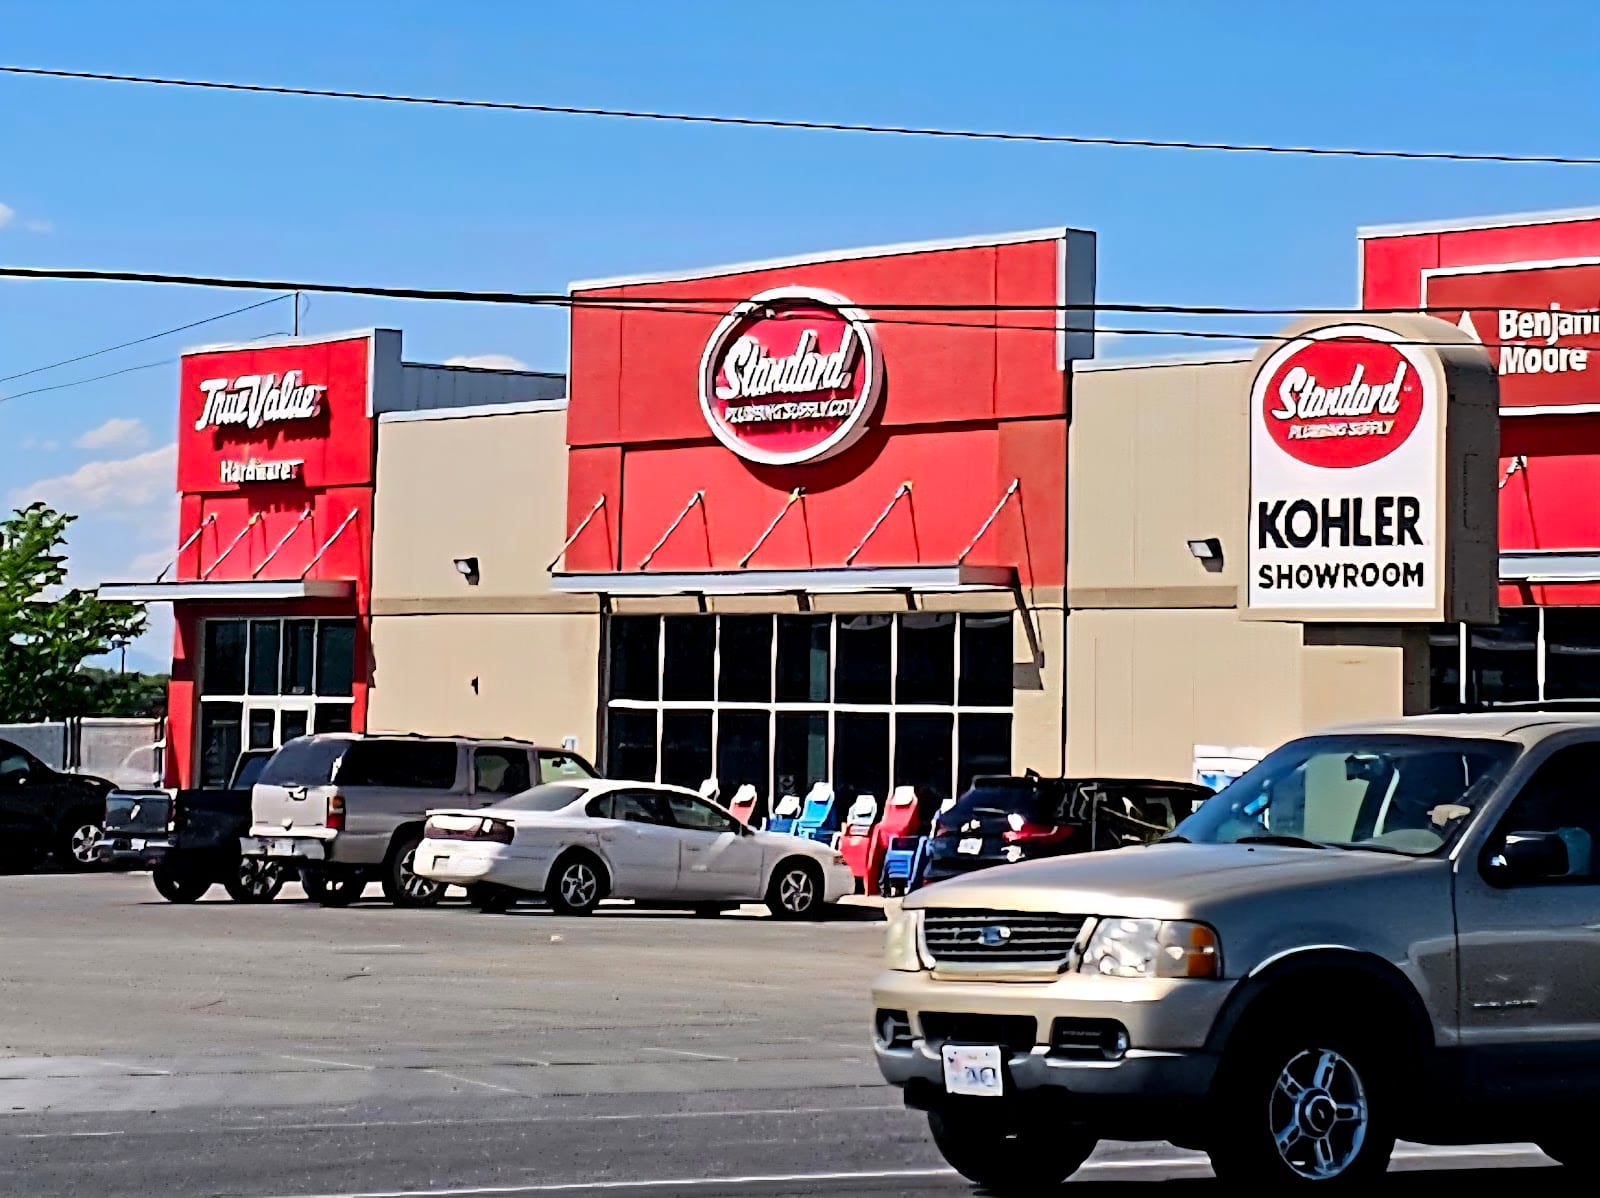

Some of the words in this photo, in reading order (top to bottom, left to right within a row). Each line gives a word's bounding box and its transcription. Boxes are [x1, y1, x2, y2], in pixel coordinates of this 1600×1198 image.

[715, 324, 853, 400] Standard
[1498, 345, 1588, 375] Moore
[1271, 360, 1407, 419] Standard
[220, 457, 297, 483] Hardware
[1258, 496, 1424, 550] KOHLER
[1258, 561, 1424, 590] SHOWROOM
